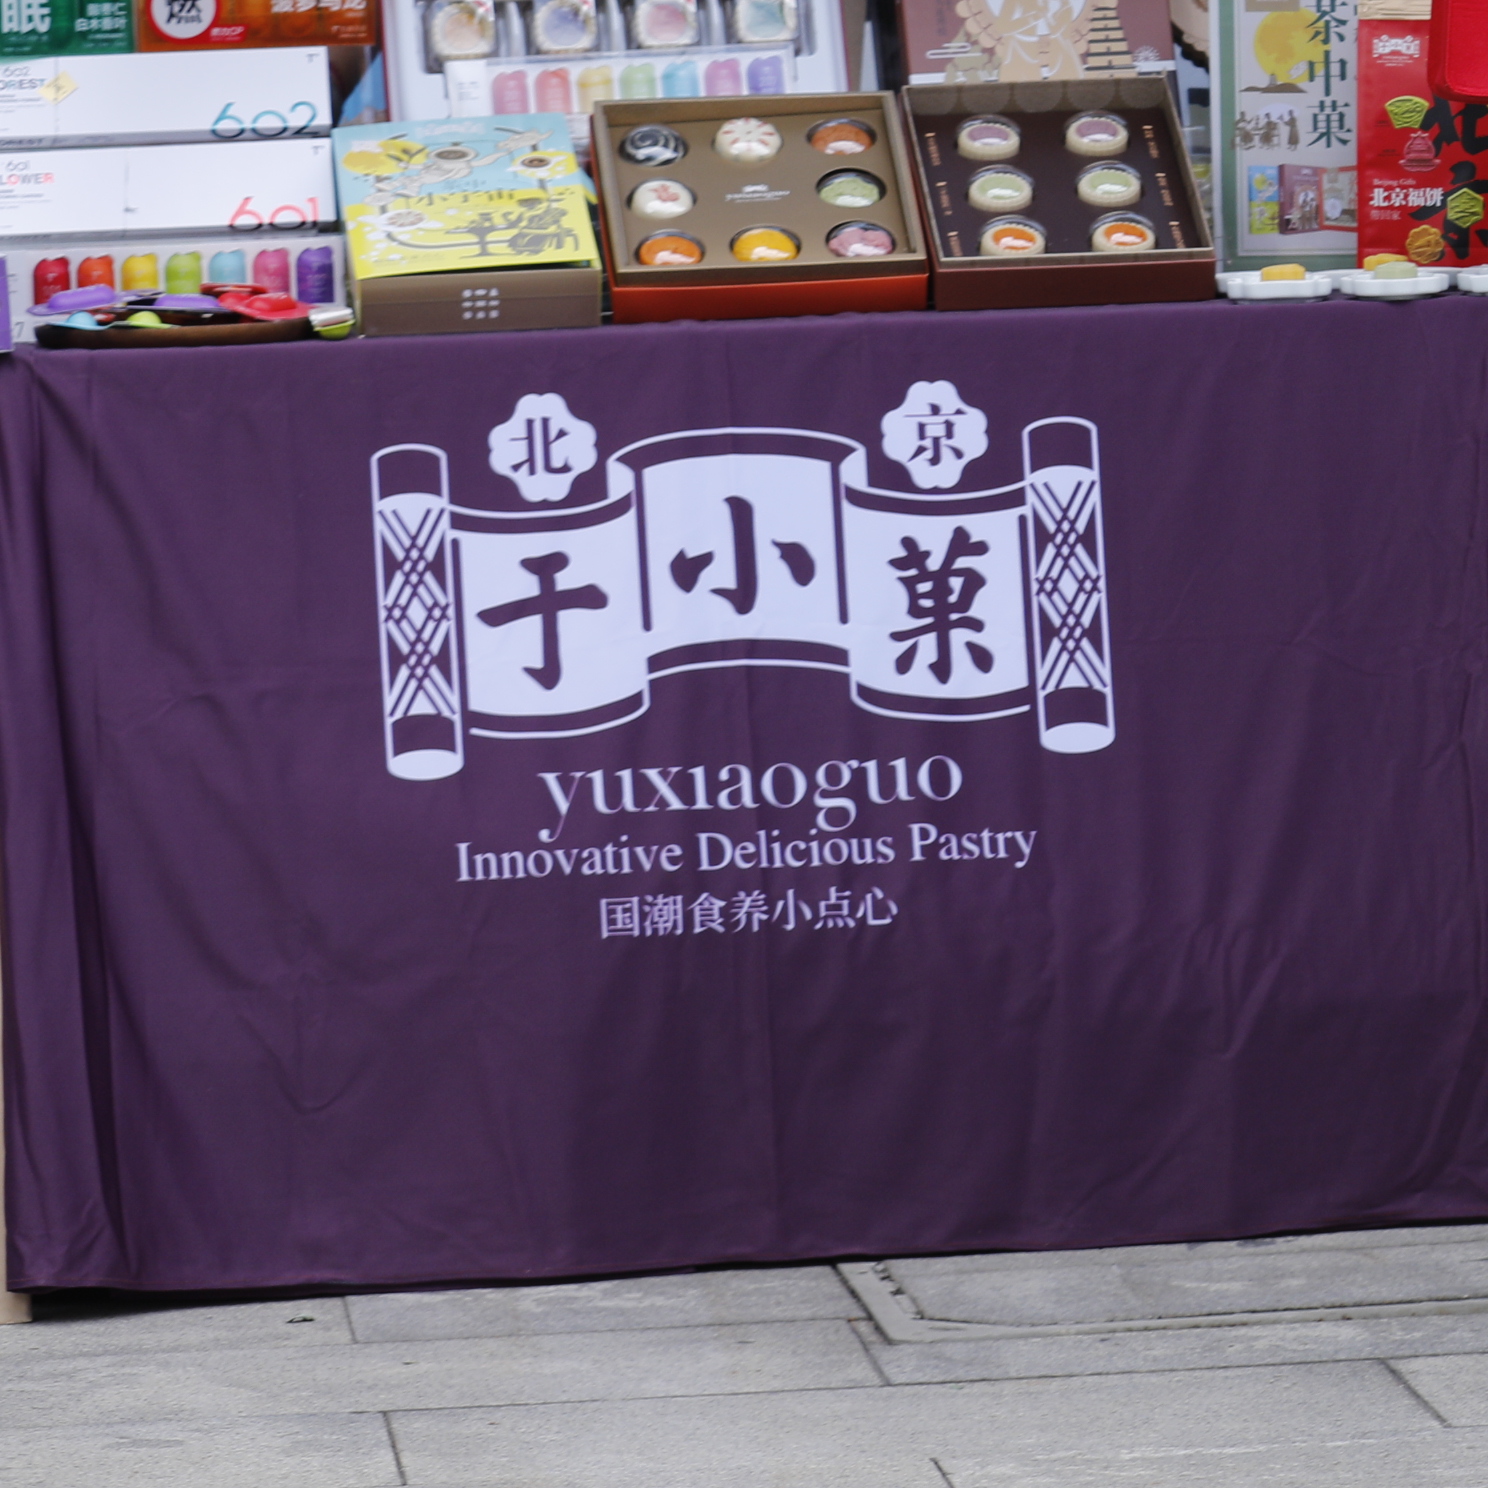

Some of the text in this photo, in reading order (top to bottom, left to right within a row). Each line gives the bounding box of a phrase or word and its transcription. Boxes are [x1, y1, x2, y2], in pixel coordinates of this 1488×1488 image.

[0, 78, 46, 90] OREST
[211, 100, 321, 139] 602
[0, 173, 54, 185] LOWER
[1369, 187, 1445, 208] 北京福饼
[230, 196, 320, 231] 601
[510, 403, 968, 478] 北 京
[537, 753, 964, 843] yuxiaoguo
[454, 821, 1038, 883] Innovative Delicious Pastry
[599, 887, 899, 940] 国潮食养小点心
